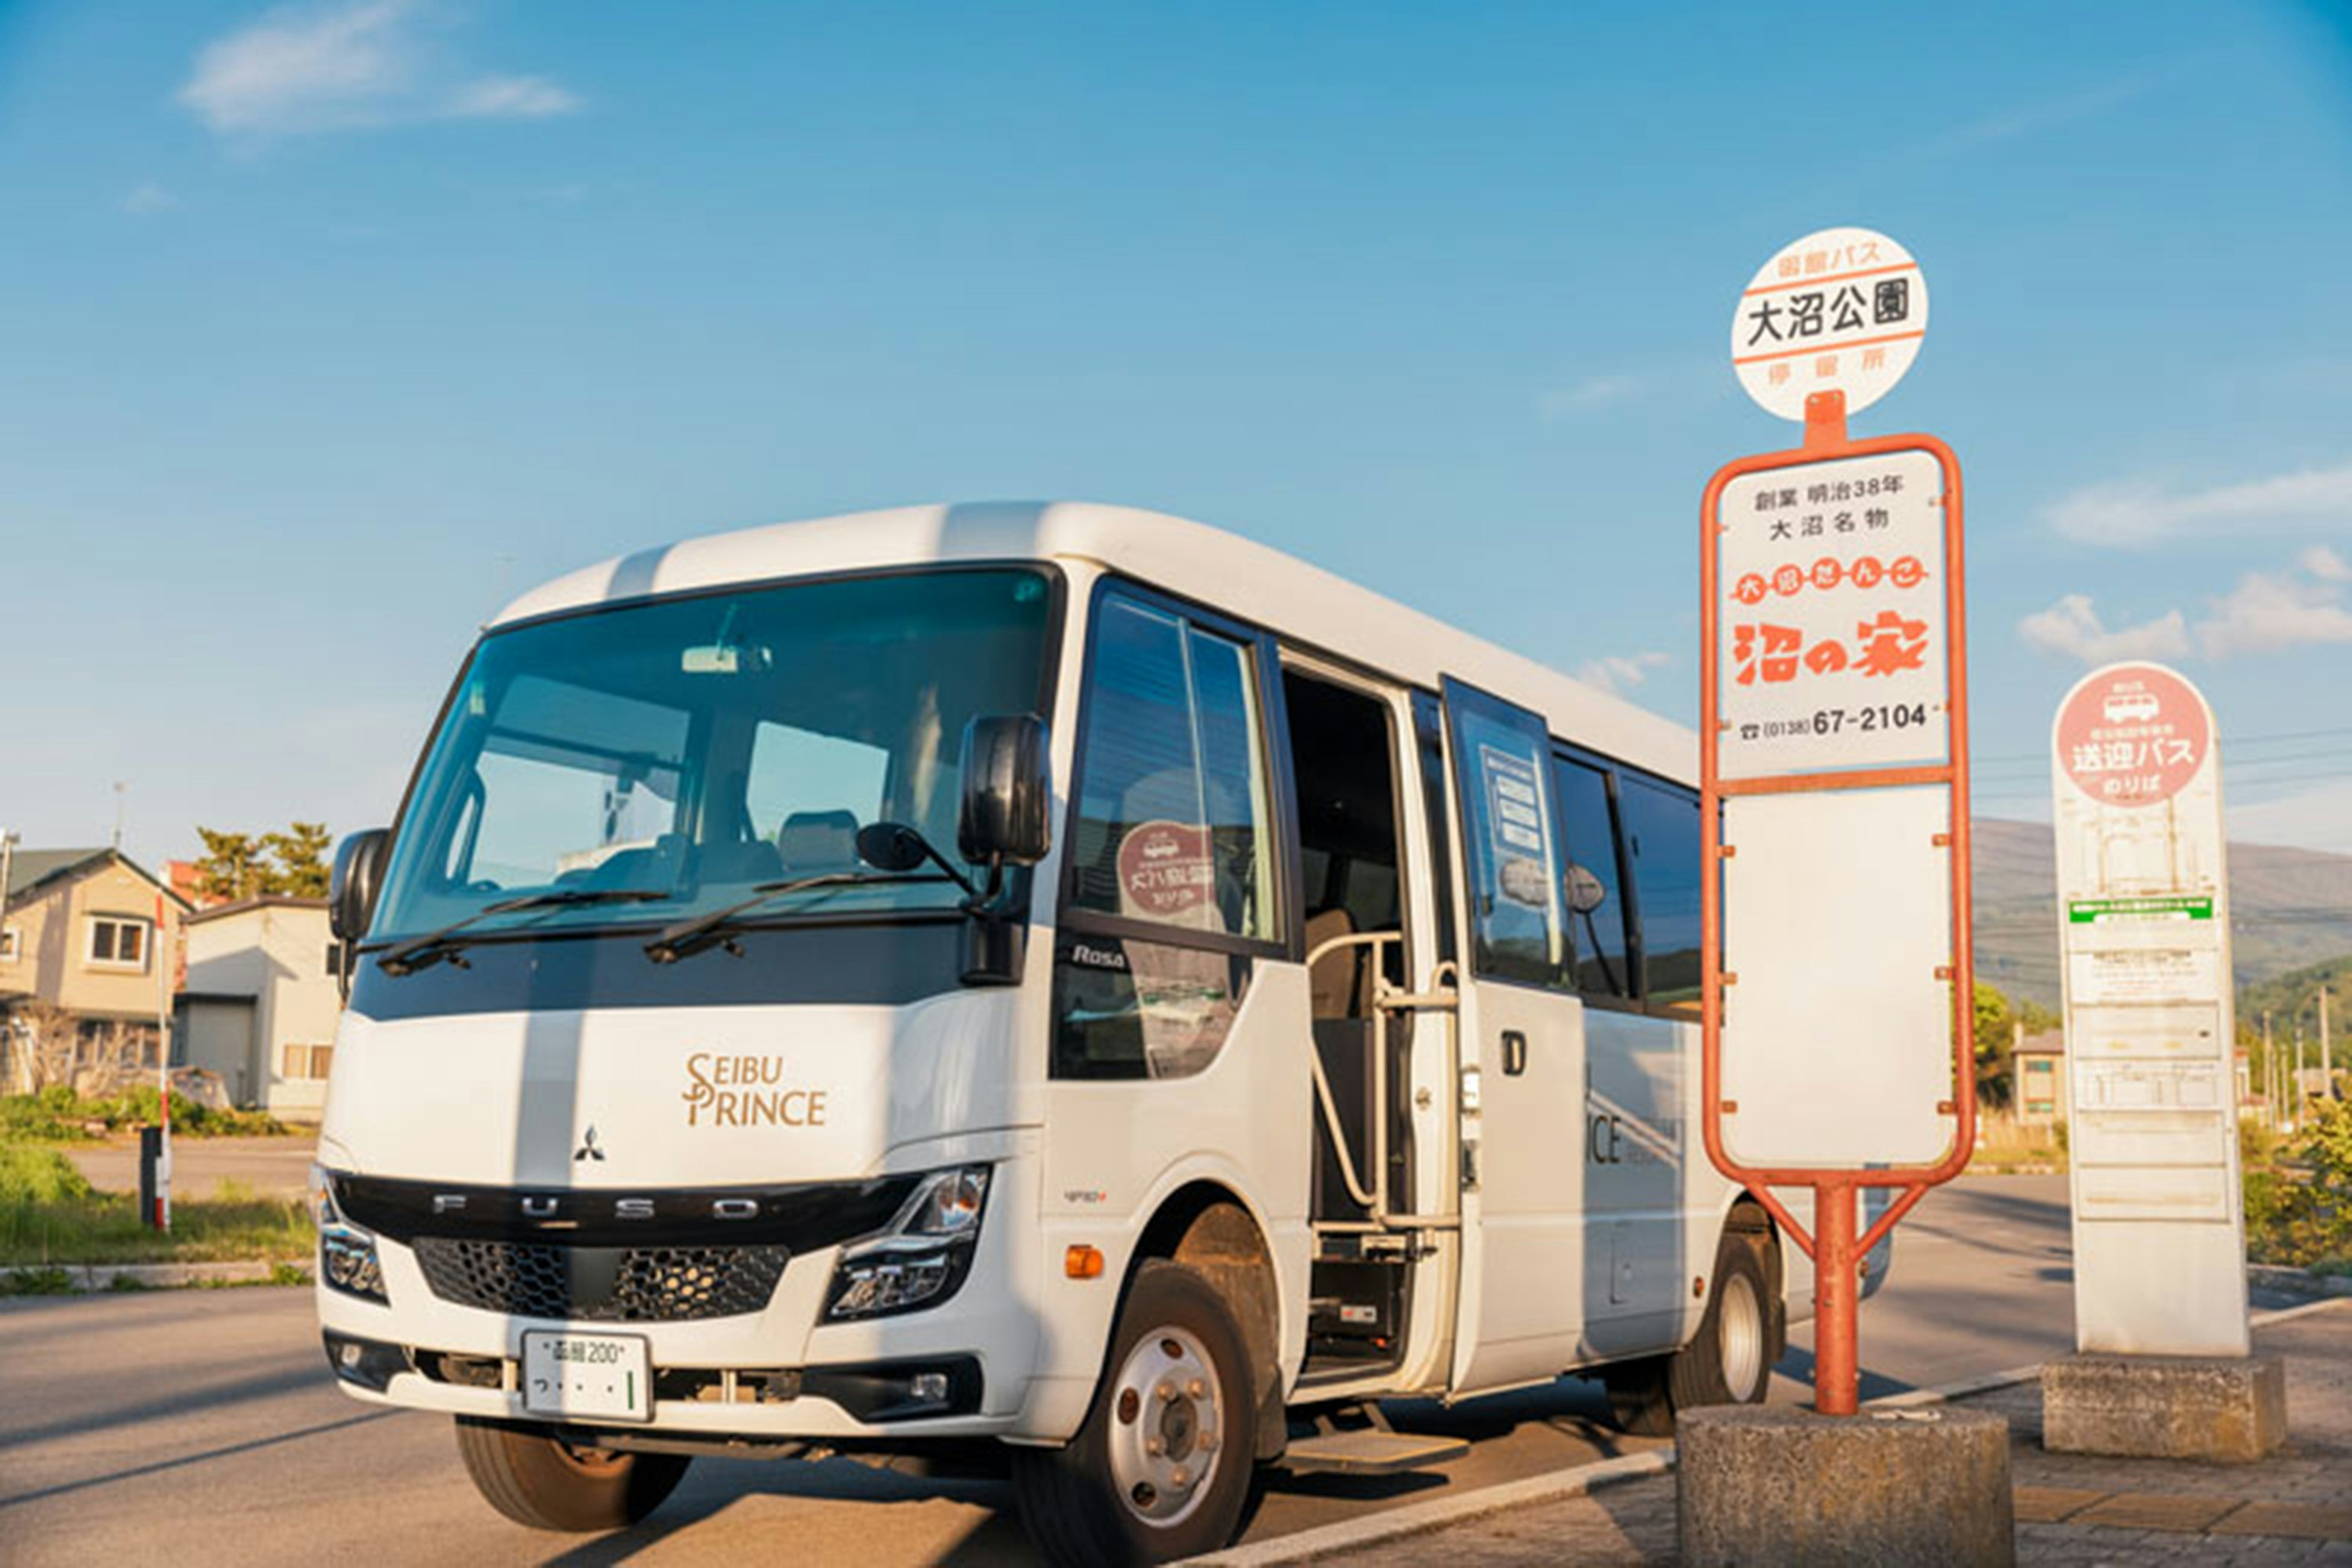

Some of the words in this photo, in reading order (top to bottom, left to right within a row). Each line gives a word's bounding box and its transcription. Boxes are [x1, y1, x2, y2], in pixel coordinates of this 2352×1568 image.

[1748, 278, 1909, 347] 大沼公園
[1807, 474, 1904, 506] 明治38年
[1769, 508, 1889, 541] 大沼名物
[1733, 610, 1929, 686] 沼の家
[1813, 703, 1926, 735] 67-2104
[2072, 737, 2194, 773] 送迎バス
[2103, 774, 2161, 794] のりば
[686, 1053, 783, 1101] SEIBU
[681, 1083, 827, 1126] PRINCE
[434, 1195, 758, 1218] FUSO
